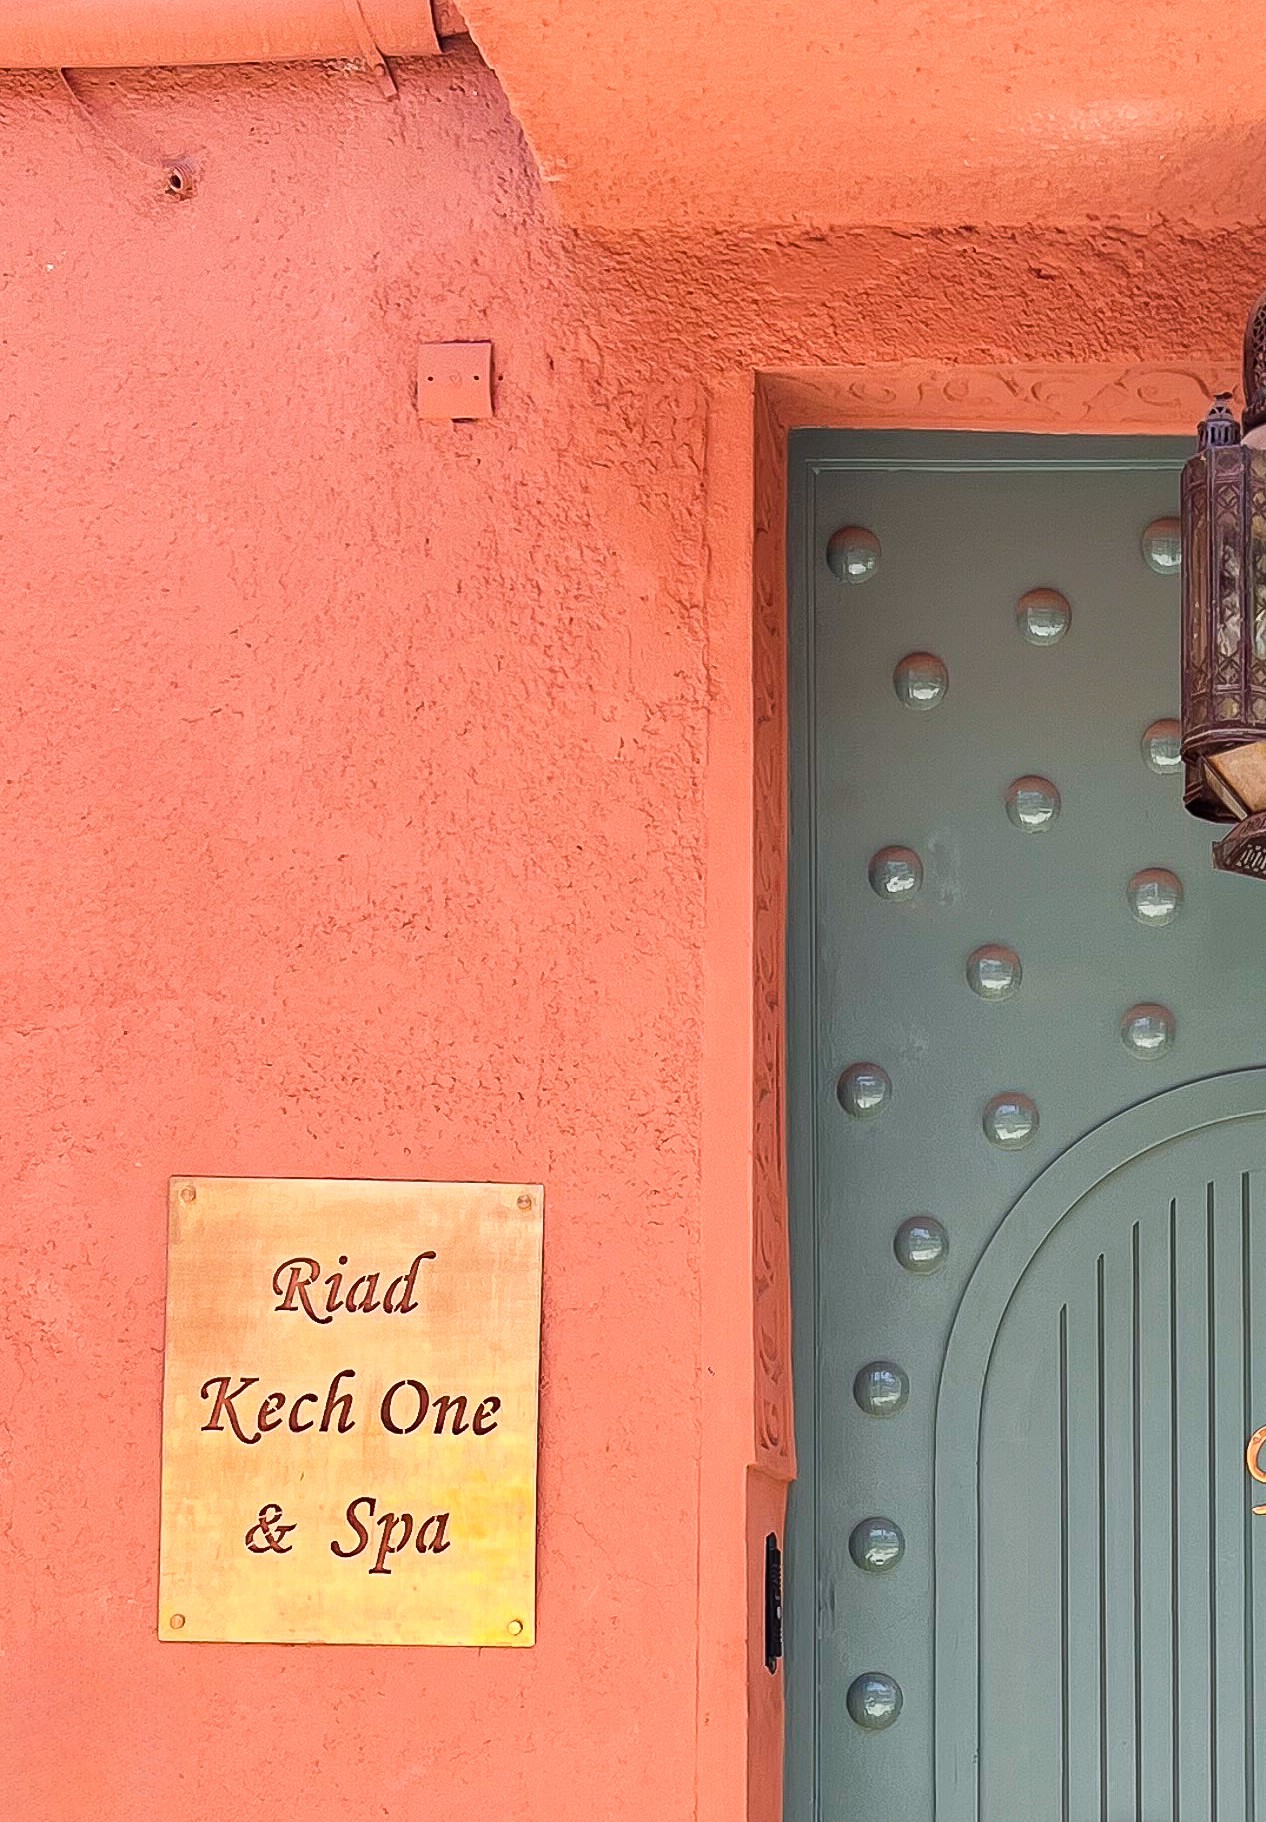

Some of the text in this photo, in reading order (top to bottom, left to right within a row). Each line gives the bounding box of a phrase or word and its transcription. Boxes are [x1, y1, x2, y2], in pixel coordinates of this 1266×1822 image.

[273, 1251, 437, 1324] Riad
[201, 1369, 501, 1444] Kech One
[245, 1497, 450, 1574] & Spa
